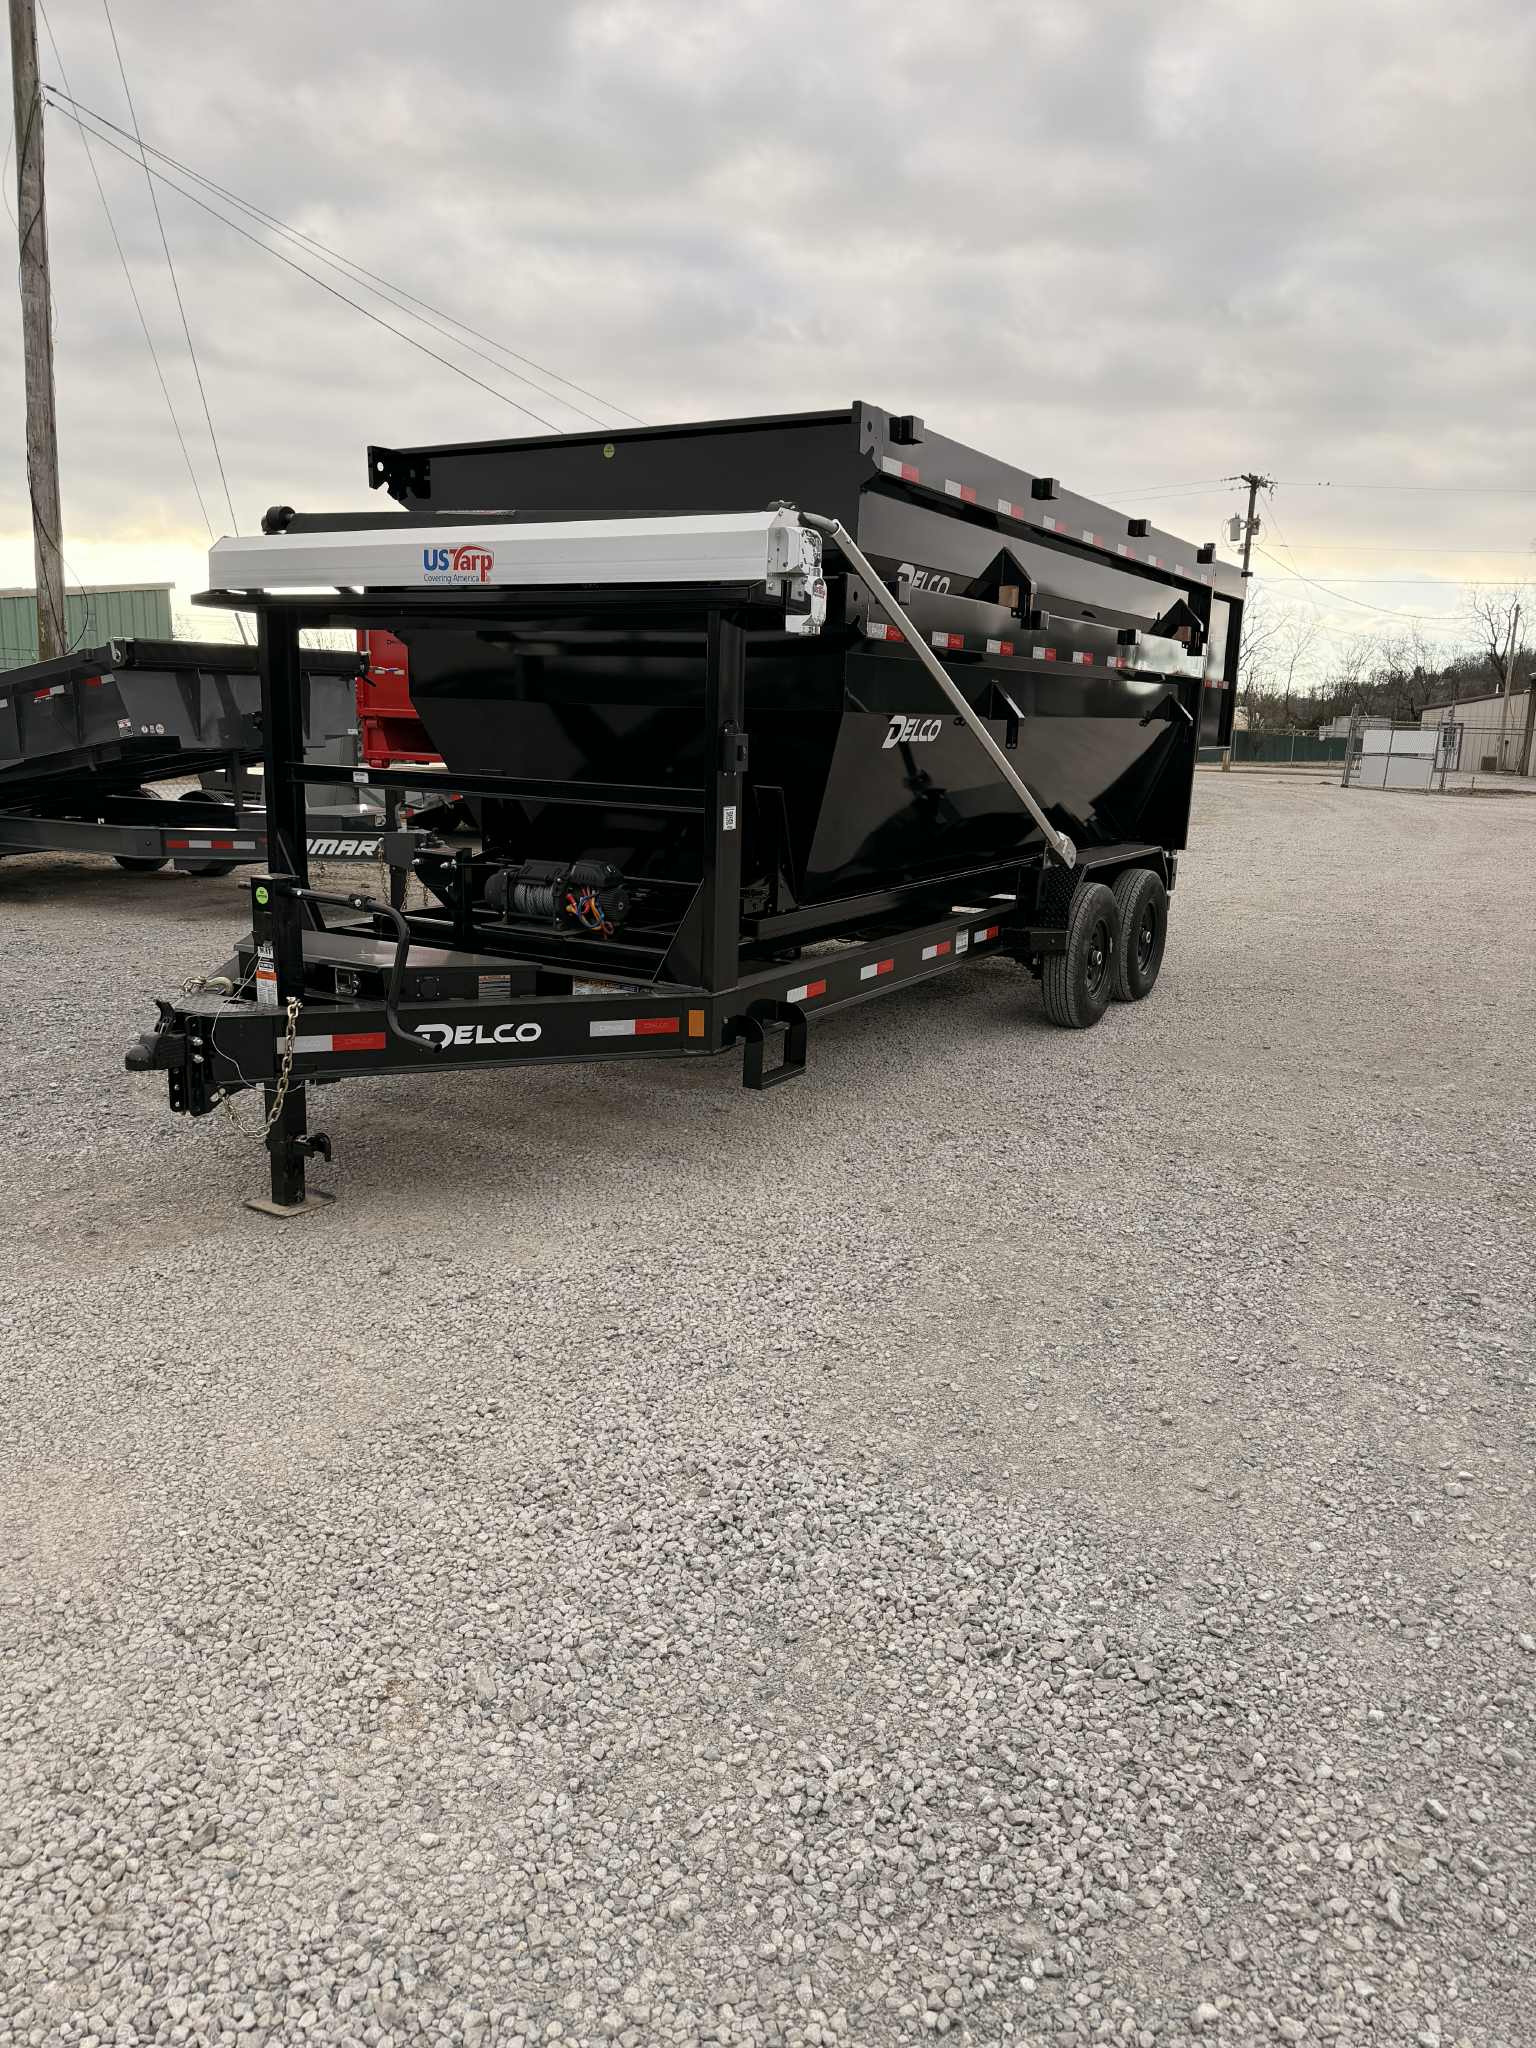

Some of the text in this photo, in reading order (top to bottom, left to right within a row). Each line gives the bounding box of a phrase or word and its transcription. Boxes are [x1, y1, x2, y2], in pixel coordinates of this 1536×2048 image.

[423, 573, 480, 584] Covering America
[882, 715, 942, 749] DELCO
